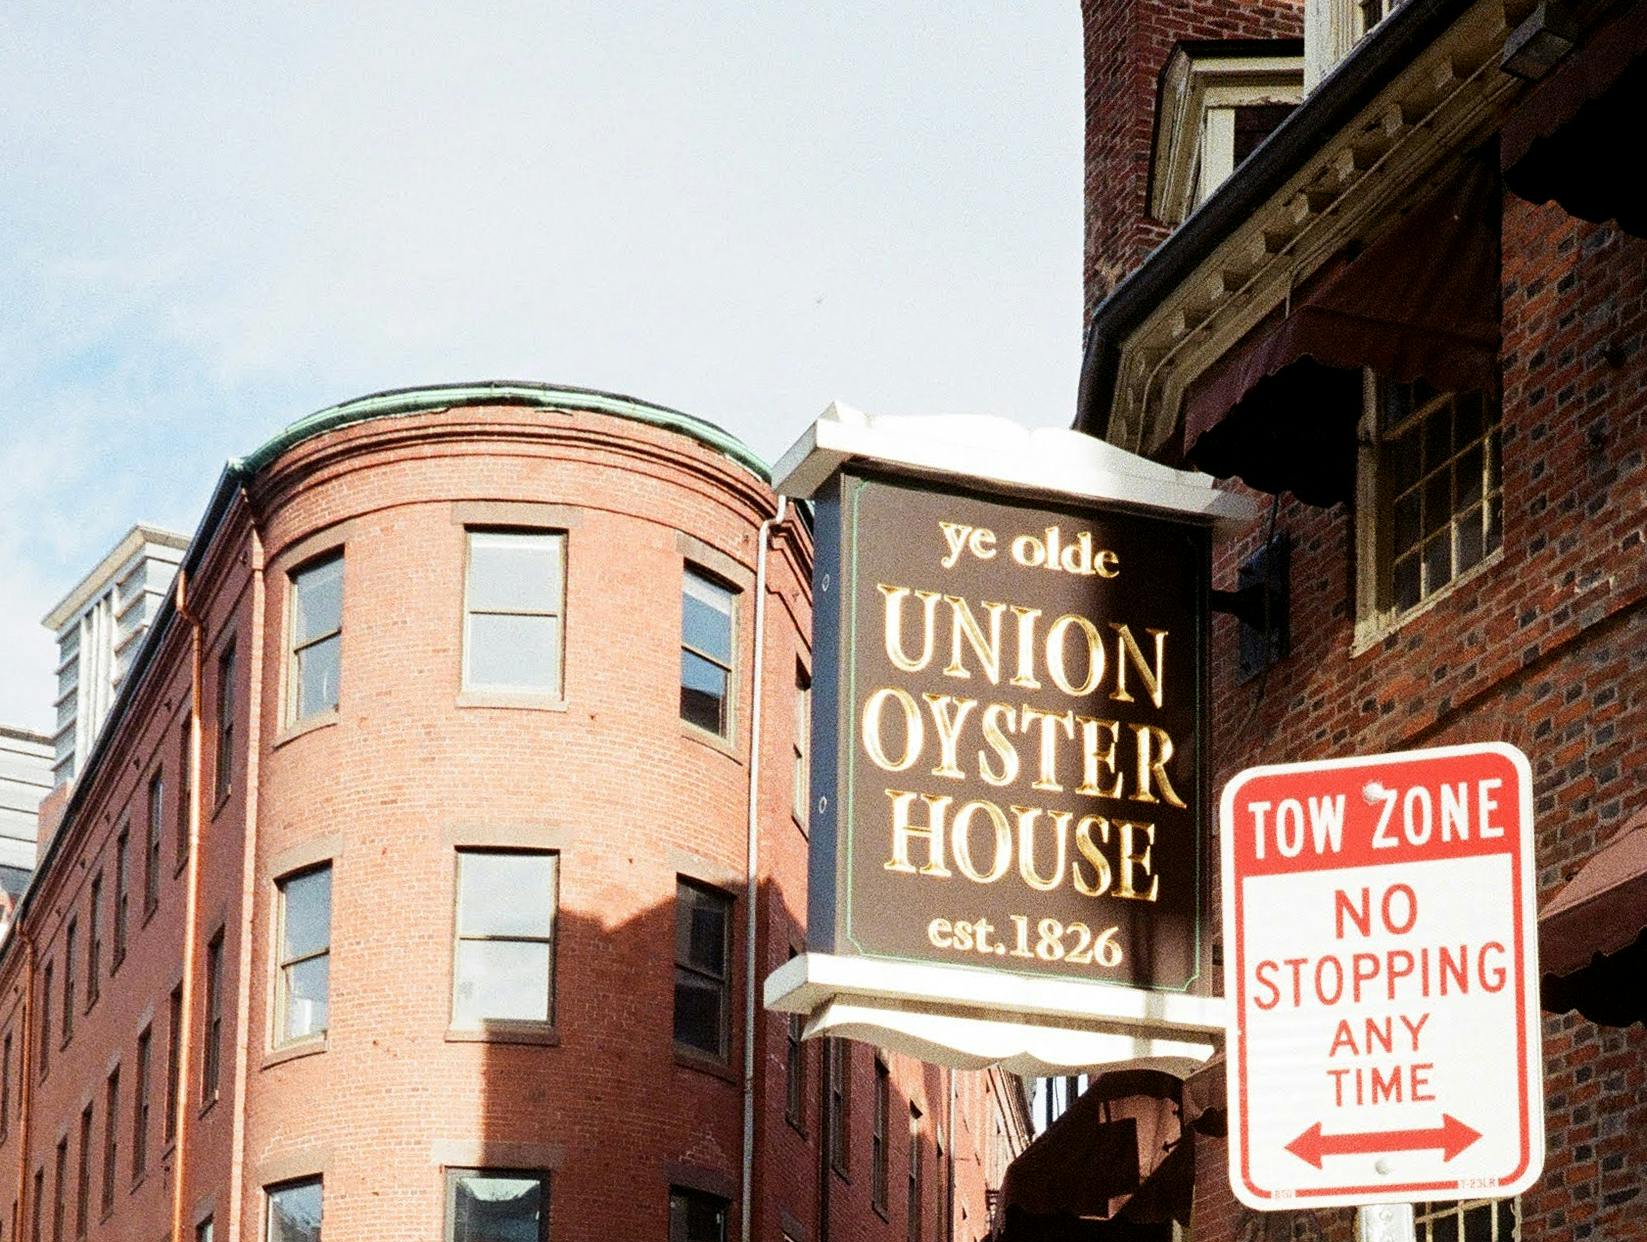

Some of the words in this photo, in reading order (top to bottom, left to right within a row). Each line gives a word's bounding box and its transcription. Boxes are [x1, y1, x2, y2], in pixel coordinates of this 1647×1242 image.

[939, 521, 997, 569] ye
[1012, 526, 1120, 579] olde
[877, 583, 1170, 708] UNION
[862, 687, 1187, 809] OYSTER
[884, 788, 1160, 902] HOUSE
[1247, 793, 1345, 860] TOW
[1372, 778, 1506, 850] ZONE
[1334, 883, 1419, 940] NO
[1254, 941, 1508, 1011] STOPPING
[1329, 1012, 1431, 1057] ANY
[1326, 1062, 1437, 1107] TIME
